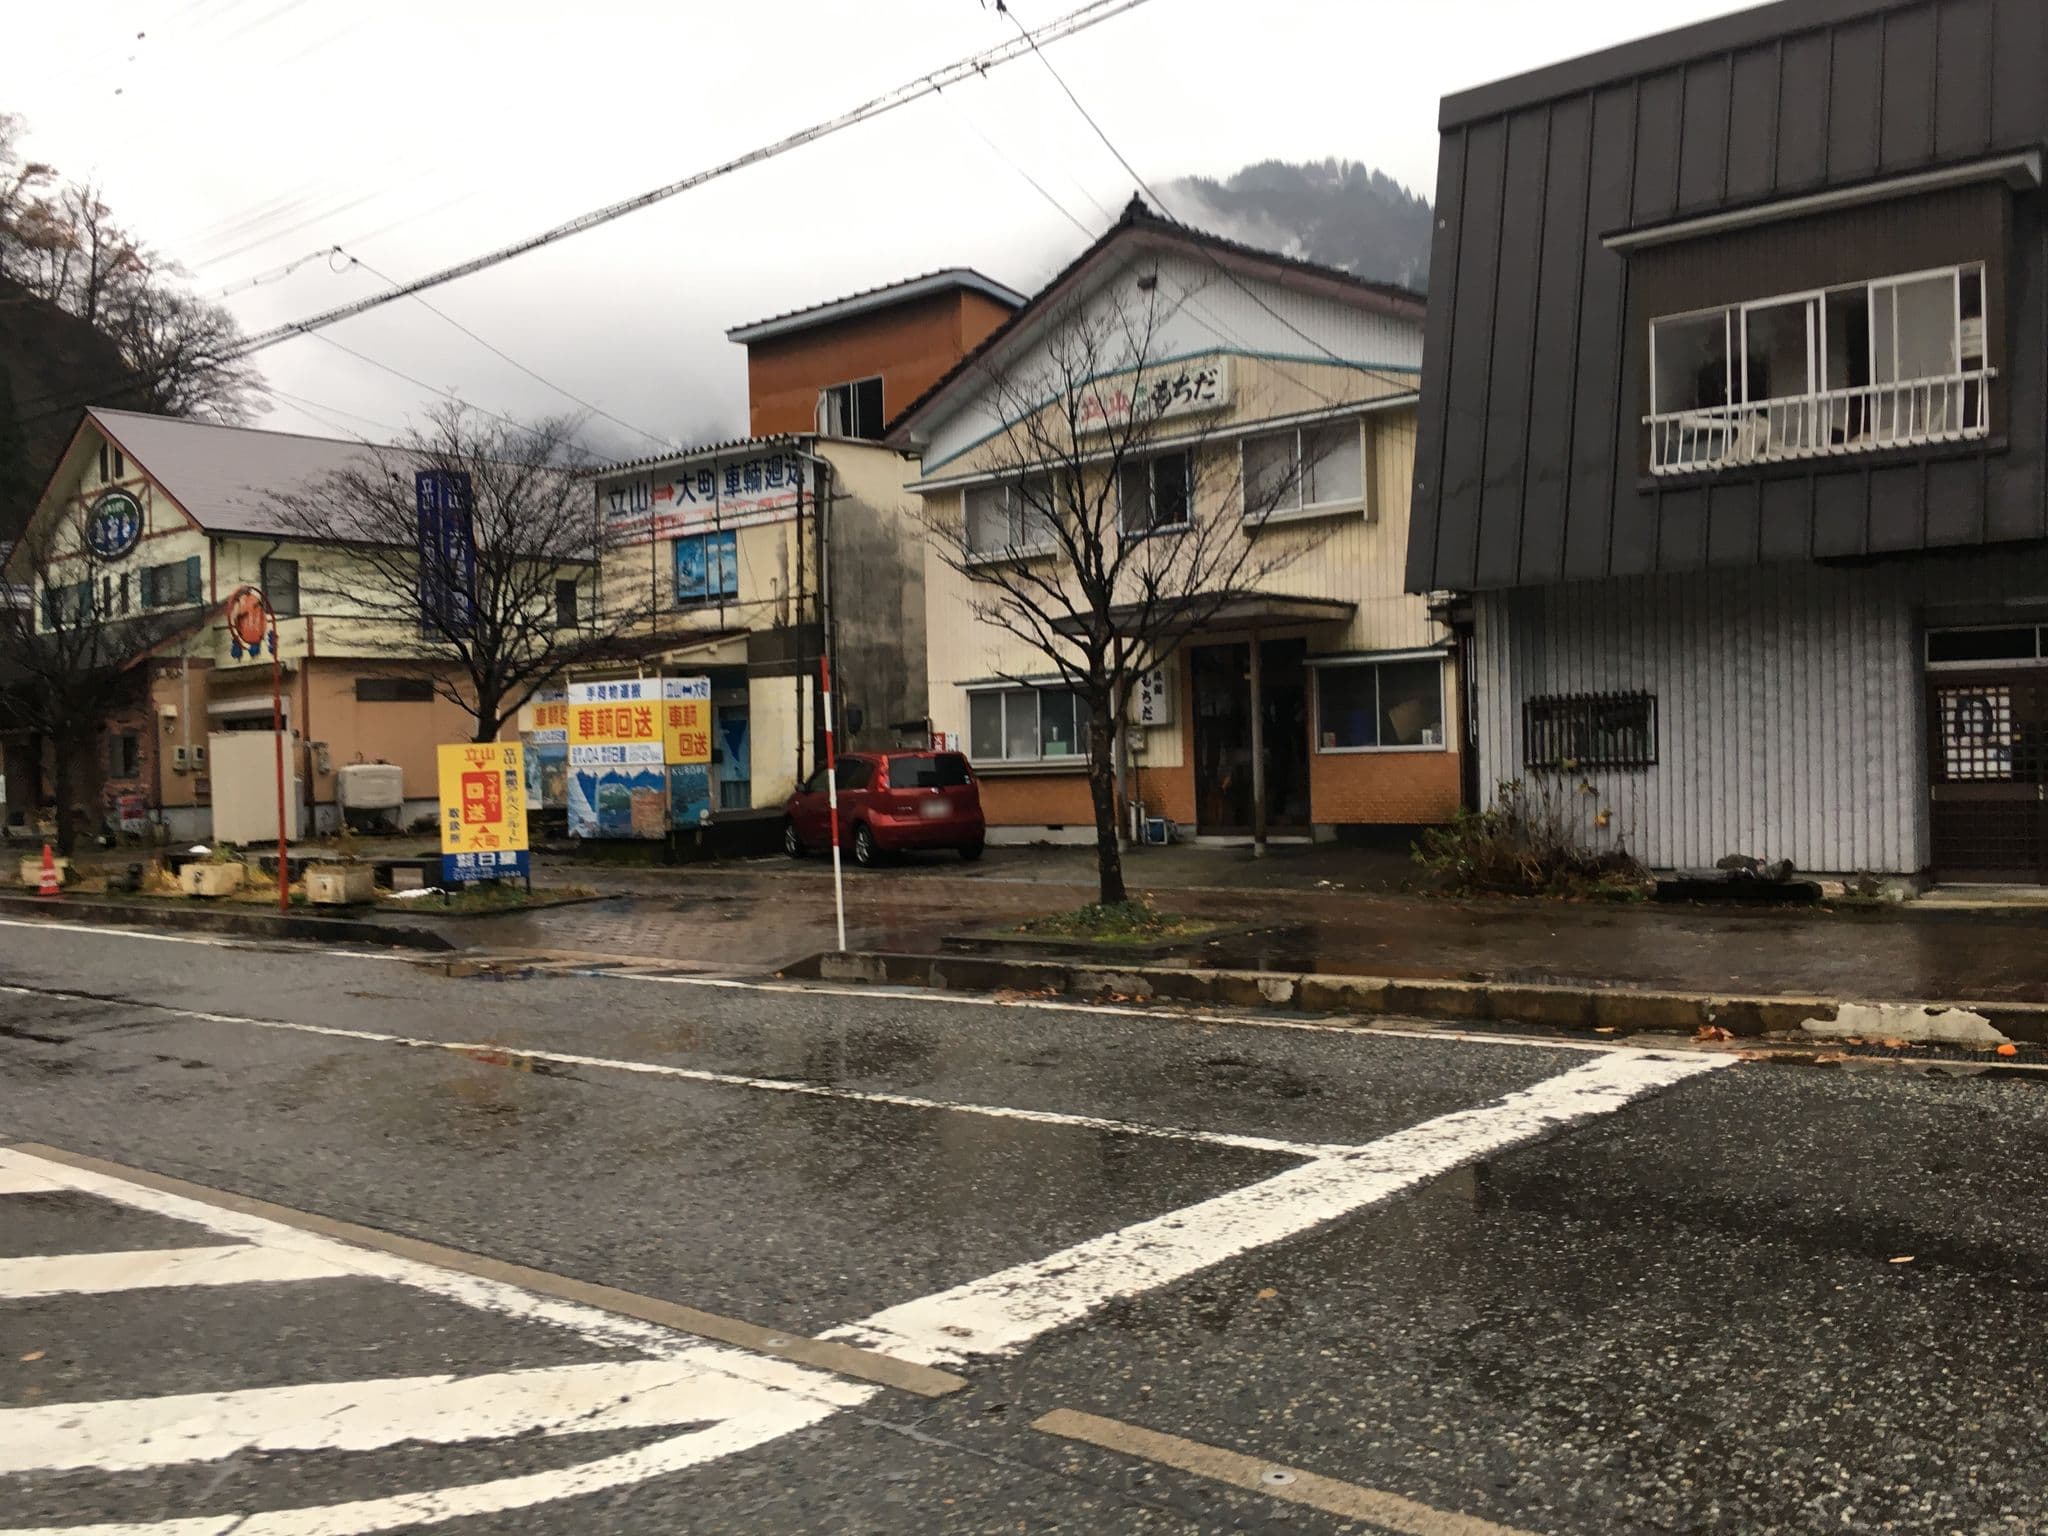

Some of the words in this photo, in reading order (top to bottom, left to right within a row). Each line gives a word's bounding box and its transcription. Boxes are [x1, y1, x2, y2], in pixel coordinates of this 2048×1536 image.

[608, 481, 649, 518] 立山
[676, 468, 716, 506] 大町
[464, 748, 496, 761] 立山
[679, 732, 708, 758] 回送
[466, 782, 486, 822] 回送
